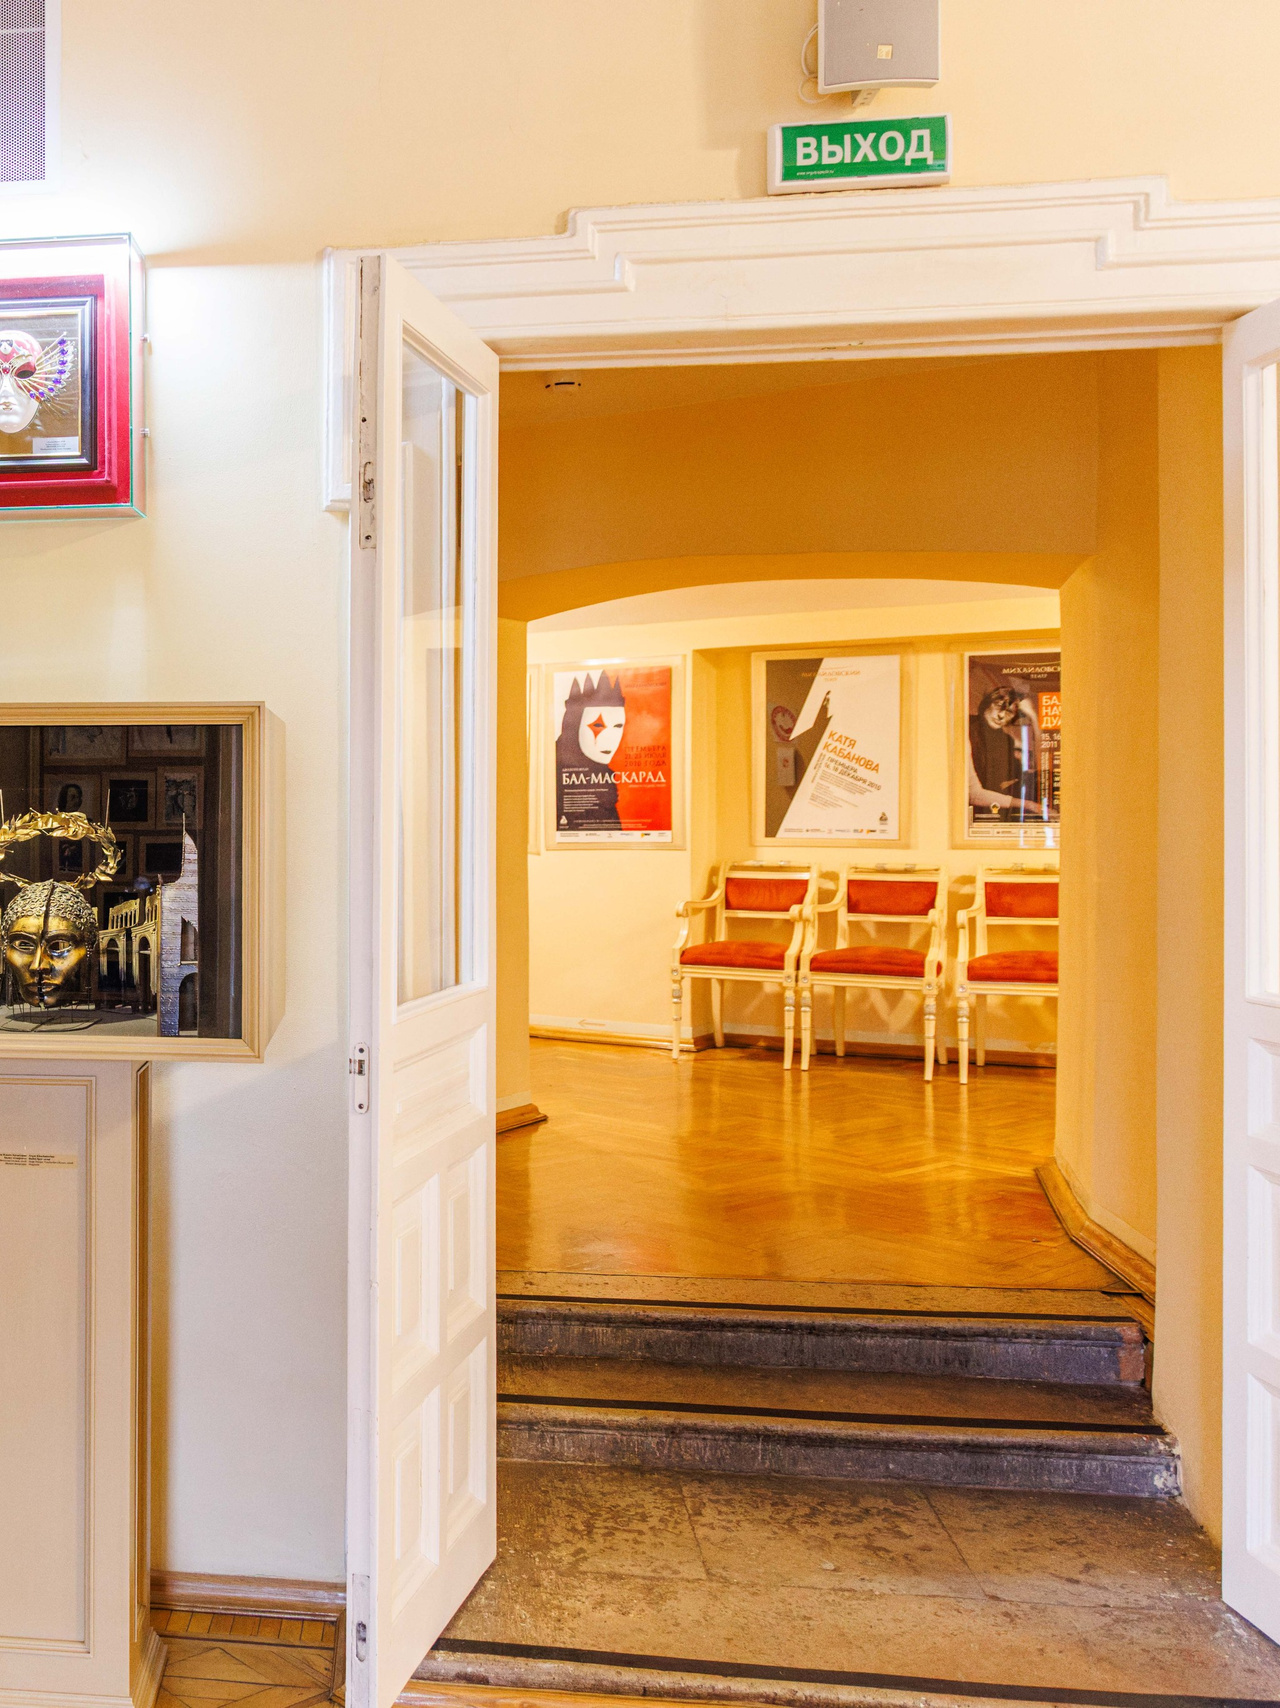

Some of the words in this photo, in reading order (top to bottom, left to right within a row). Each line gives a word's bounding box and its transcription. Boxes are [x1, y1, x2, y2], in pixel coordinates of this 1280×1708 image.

[796, 129, 934, 167] ВЫХОД
[1042, 695, 1061, 706] БА
[827, 730, 857, 750] КАТЯ
[822, 741, 880, 774] КАБАНОВА
[827, 756, 858, 774] ПРЕМЬЕРА
[562, 770, 667, 785] БАЛ-МАСКАРАД
[838, 767, 868, 785] ДЕКАБРЯ
[867, 780, 882, 791] 2010
